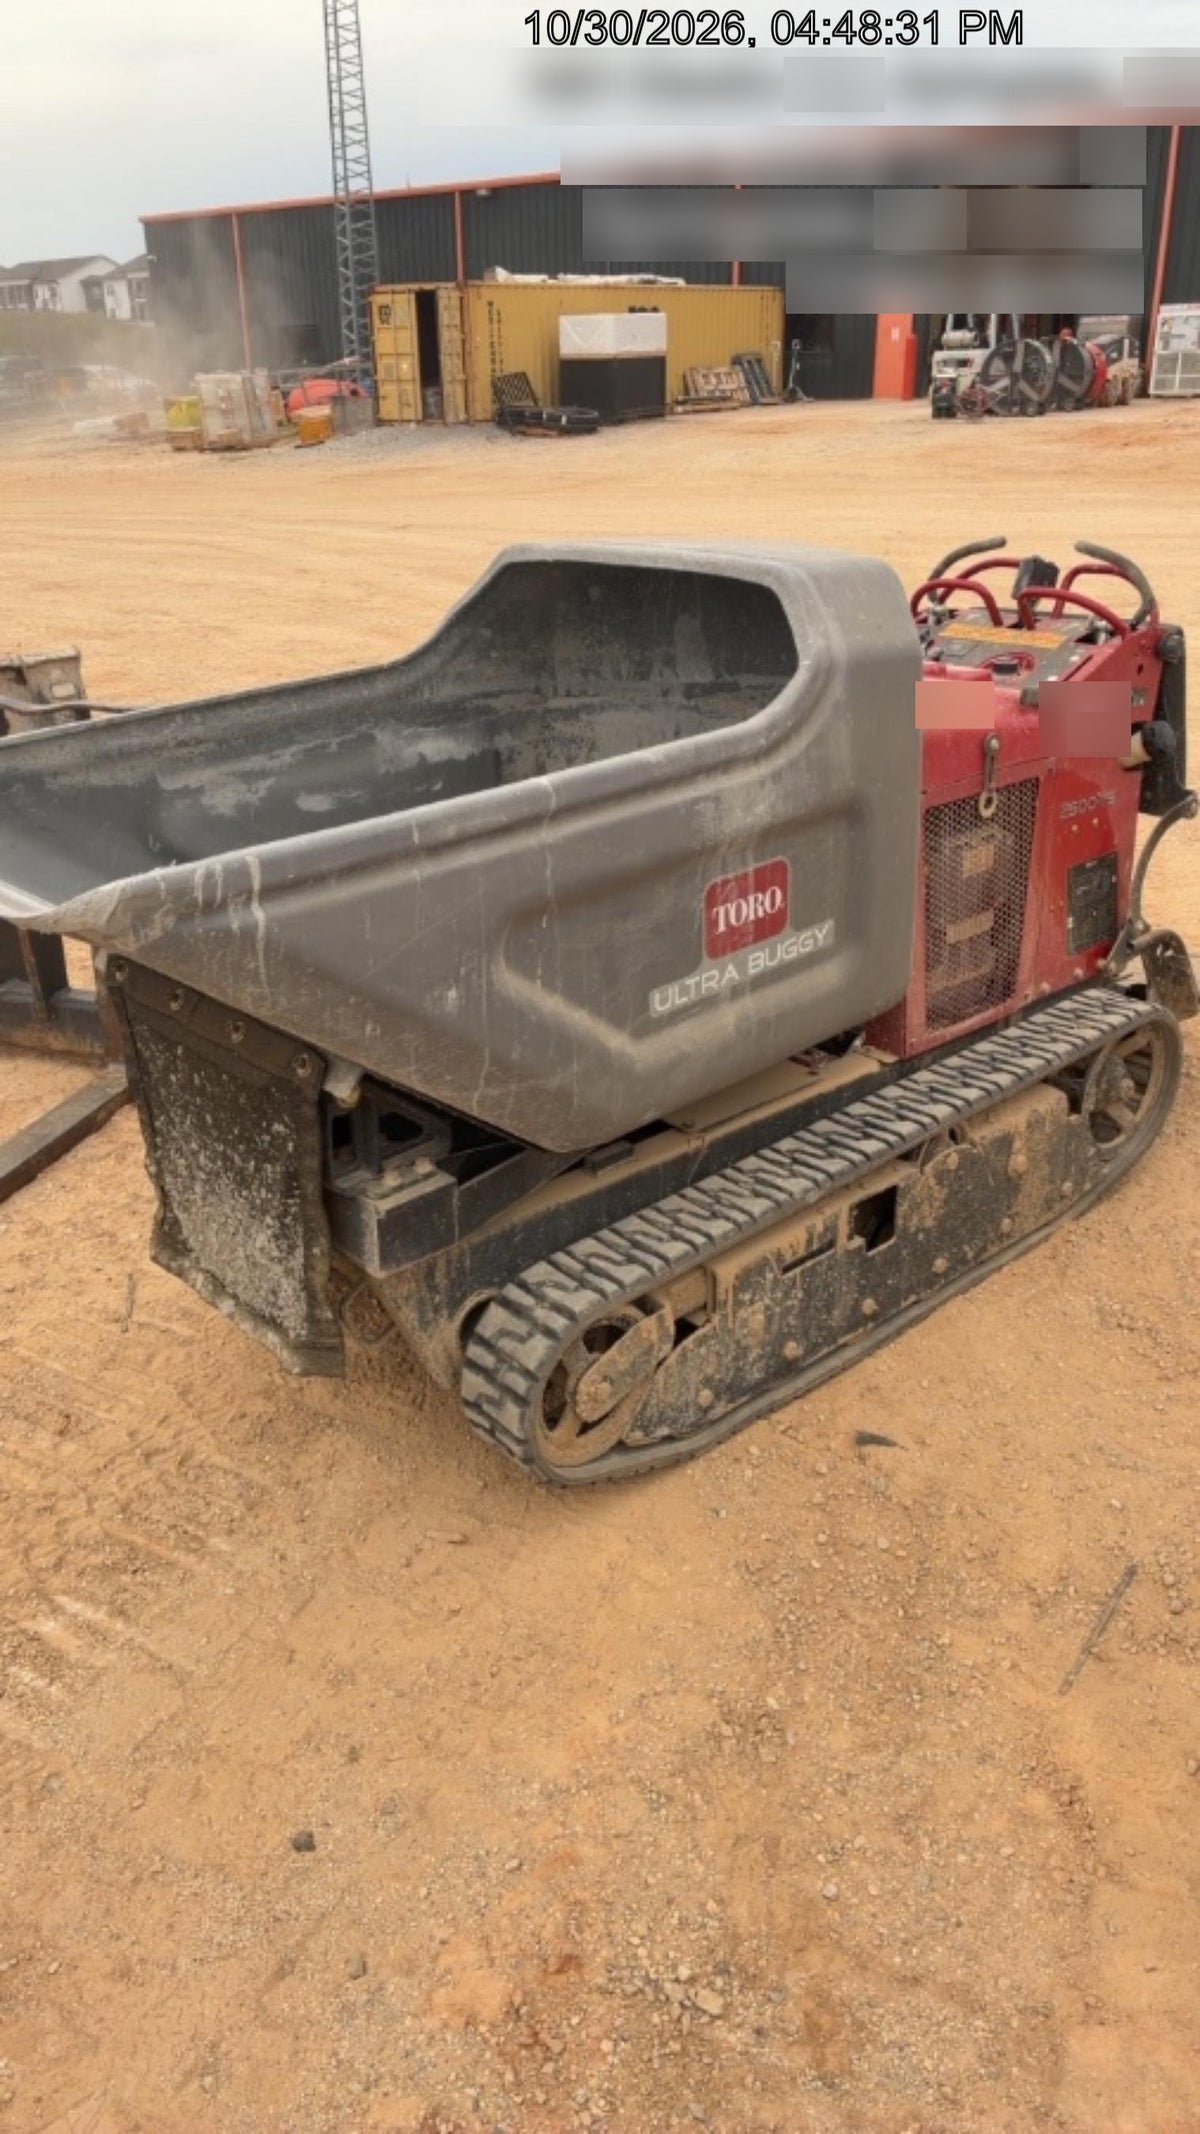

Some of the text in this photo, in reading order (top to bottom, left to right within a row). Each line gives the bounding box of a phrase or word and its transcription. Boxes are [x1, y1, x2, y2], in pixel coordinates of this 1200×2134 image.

[711, 886, 783, 935] TORO
[652, 923, 830, 1012] ULTRA BUGGY
